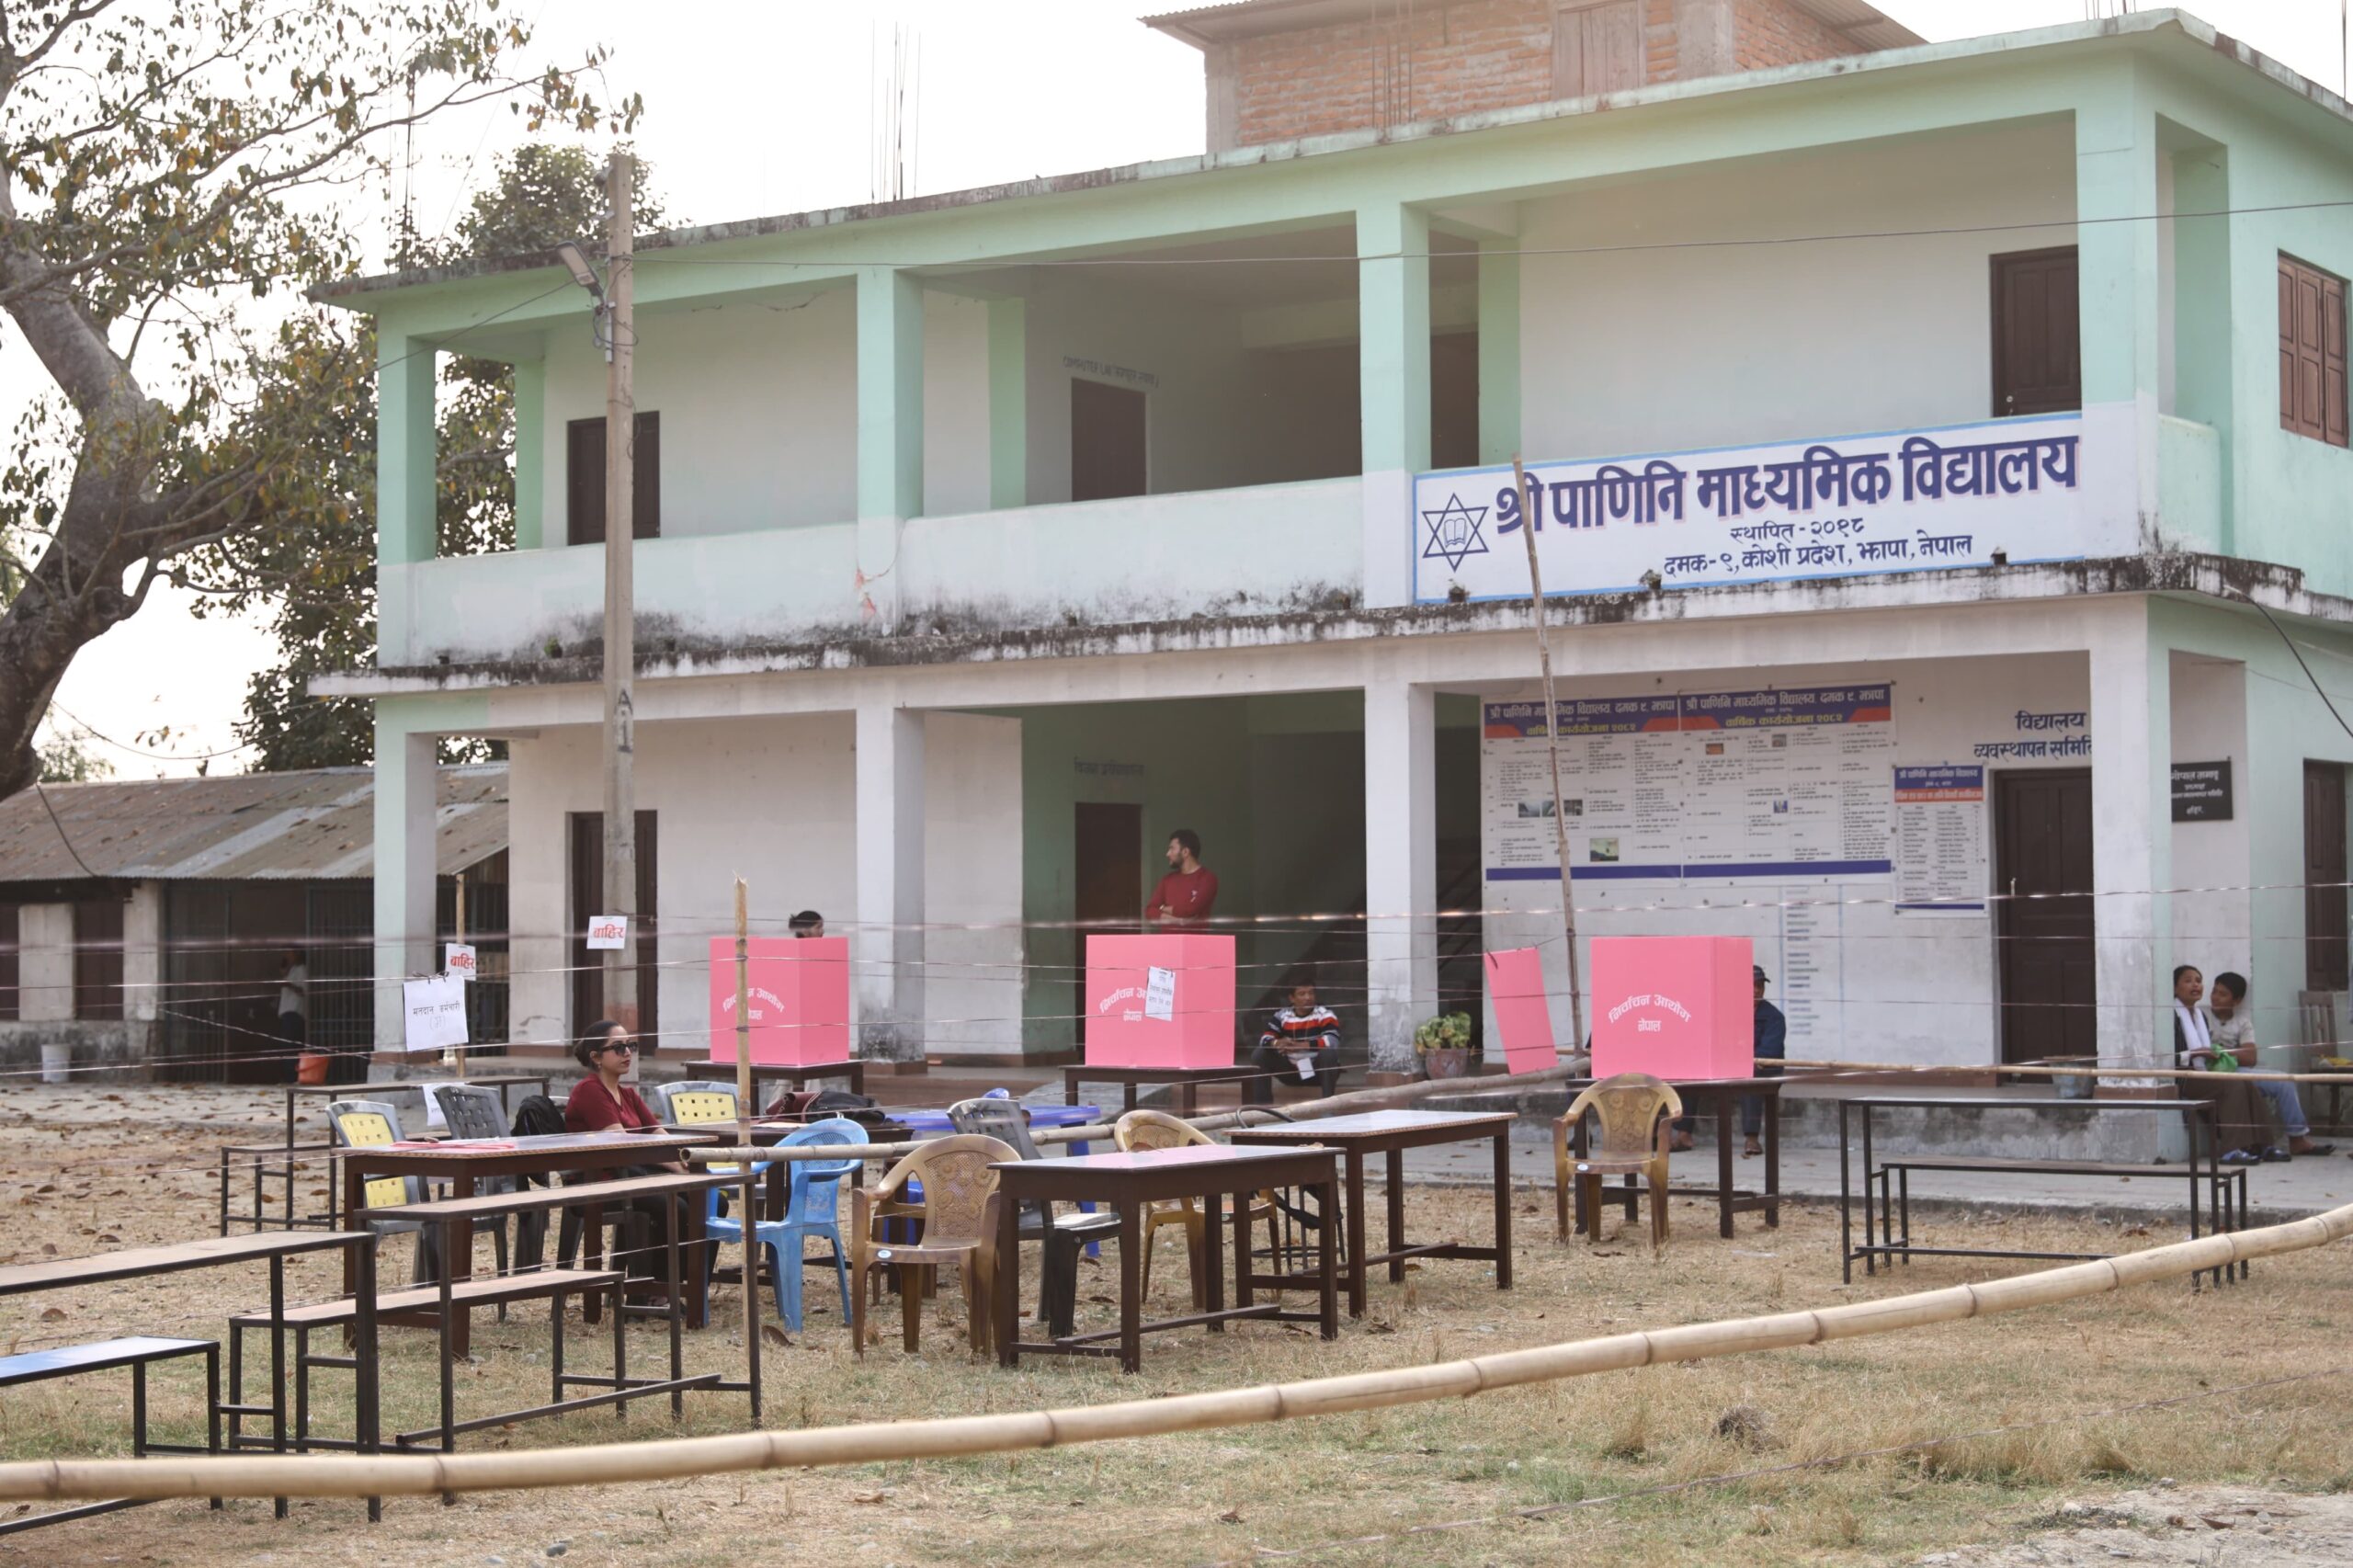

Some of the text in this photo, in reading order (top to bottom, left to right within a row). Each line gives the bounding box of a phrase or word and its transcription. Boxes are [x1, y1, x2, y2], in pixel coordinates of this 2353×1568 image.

[1496, 436, 2079, 534] श्री पाणिनि माध्यमिक विद्यालय
[1730, 520, 1794, 543] स्थापित
[1742, 542, 1790, 574] कोशी
[1796, 540, 1853, 570] प्रदेश,
[1917, 529, 1973, 557] नेपाल
[2015, 710, 2086, 733] विद्यालय
[1973, 741, 2047, 762] व्यवस्थापन
[594, 924, 625, 938] बाहिर
[450, 952, 474, 970] बाहिर
[412, 1006, 435, 1017] मतदान
[1099, 987, 1135, 1014] निर्वाचन
[1608, 994, 1692, 1023] निर्वाचन आयोग
[1637, 1017, 1662, 1032] नेपाल
